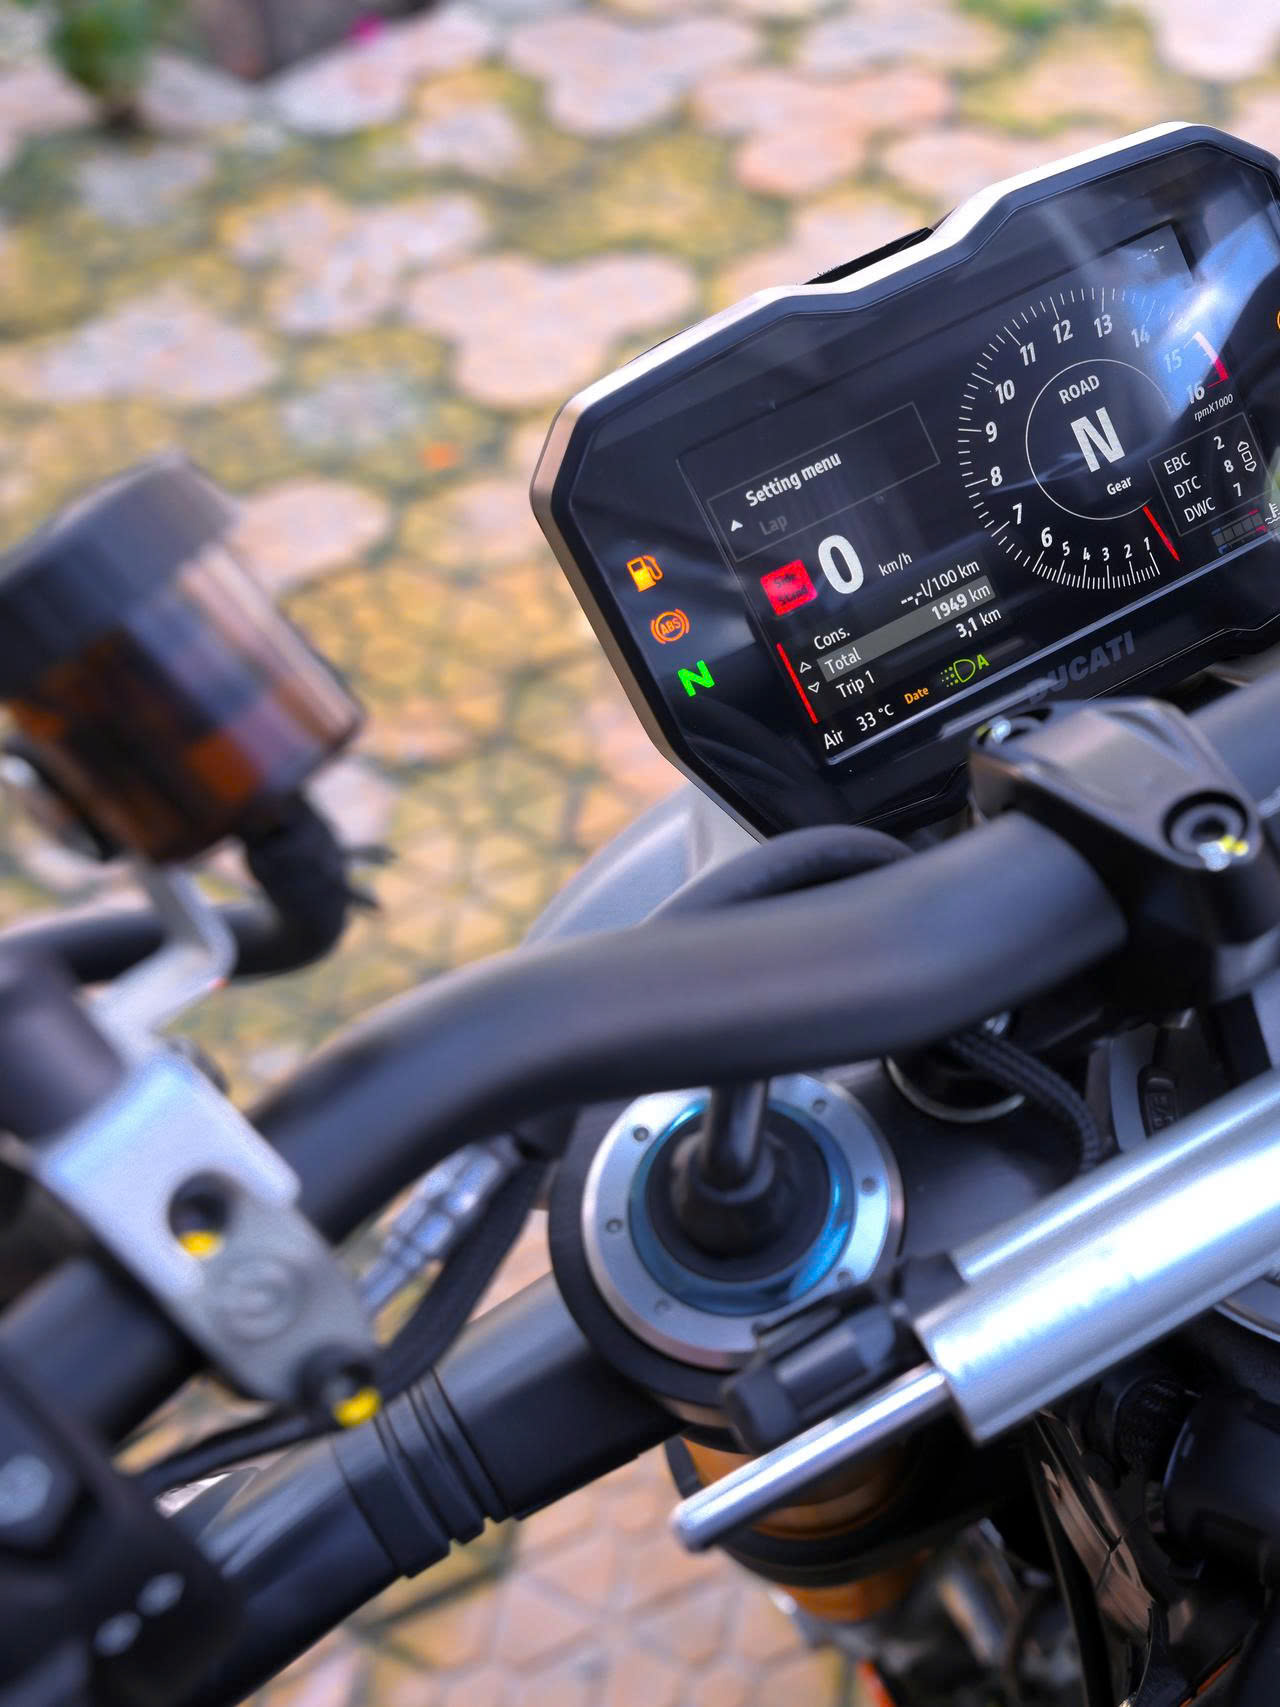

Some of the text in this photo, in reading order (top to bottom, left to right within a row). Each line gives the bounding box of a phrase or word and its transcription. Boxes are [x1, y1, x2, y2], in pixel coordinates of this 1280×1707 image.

[1052, 319, 1074, 344] 12
[1093, 314, 1113, 338] 13
[1131, 325, 1151, 348] 14
[1019, 342, 1037, 366] 11
[1164, 350, 1183, 373] 15
[995, 379, 1016, 405] 10
[1059, 374, 1100, 405] ROAD
[1186, 381, 1206, 405] 16
[1194, 393, 1234, 422] rpmX1000
[985, 421, 998, 443] 9
[1070, 406, 1126, 473] N
[1163, 435, 1225, 475] EBC 2
[745, 452, 842, 507] Setting menu
[990, 466, 1003, 487] 8
[1106, 476, 1133, 496] Gear
[1173, 459, 1235, 499] DTC 8
[1012, 502, 1023, 525] 7
[1183, 482, 1242, 523] DWC 7
[758, 514, 788, 536] Lap
[1040, 526, 1053, 548] 6
[1062, 540, 1071, 557] 5
[1082, 547, 1091, 561] 4
[1101, 547, 1110, 562] 3
[1123, 544, 1133, 559] 2
[1143, 536, 1151, 551] 1
[817, 534, 913, 595] 0 km/h
[813, 627, 851, 650] Cons.
[957, 560, 980, 579] km
[659, 617, 681, 635] ABS
[824, 584, 991, 674] Total 1949 km
[835, 608, 1002, 698] Trip 1 3,1 km
[677, 659, 715, 697] N
[903, 687, 930, 705] Date
[823, 703, 895, 750] Air 33 °C
